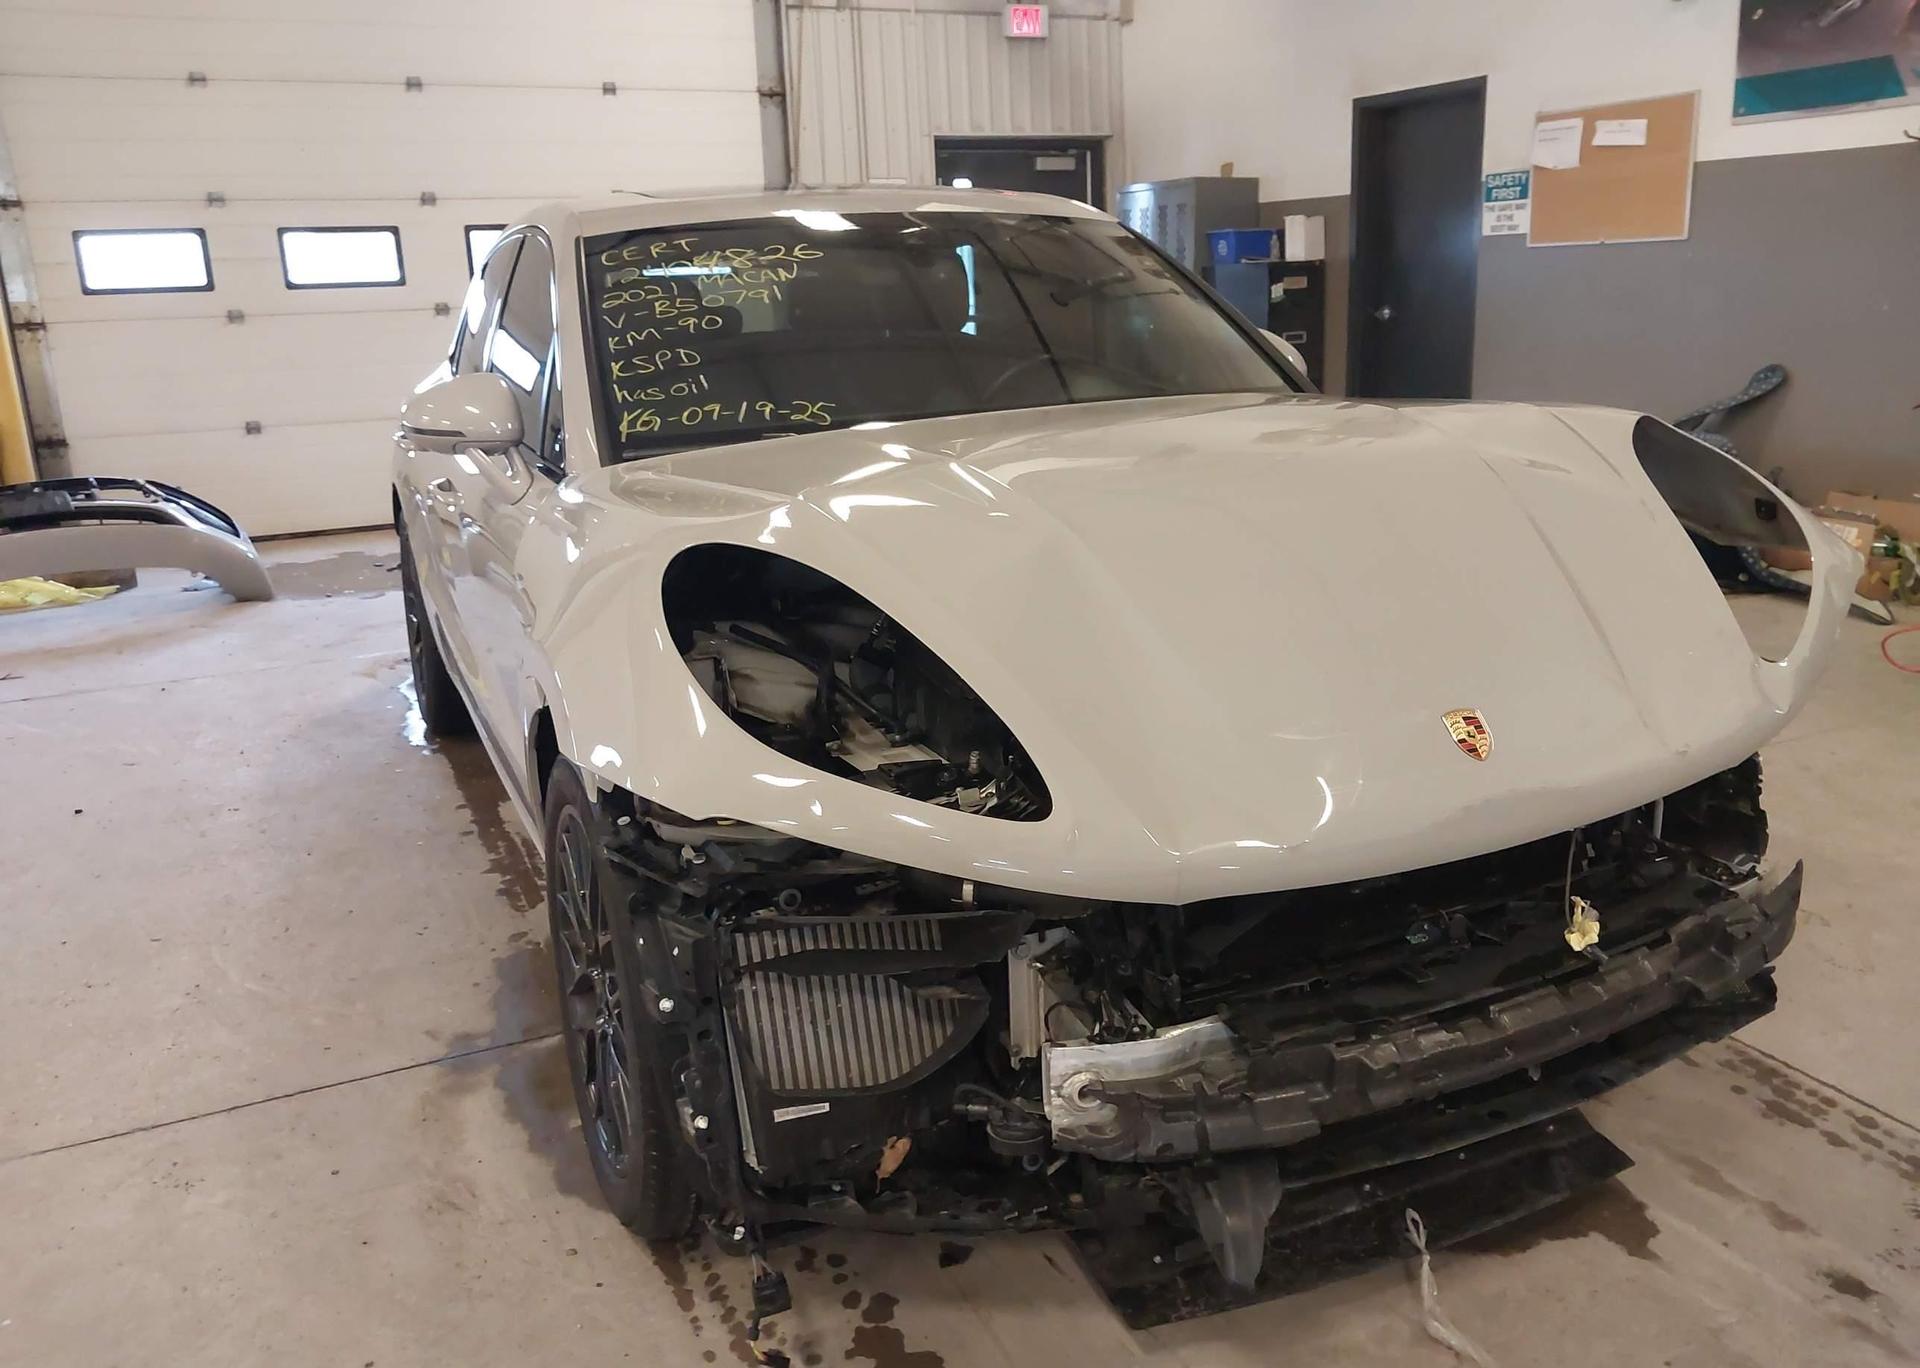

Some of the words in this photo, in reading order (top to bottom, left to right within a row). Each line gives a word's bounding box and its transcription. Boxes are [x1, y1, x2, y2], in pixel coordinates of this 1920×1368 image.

[1487, 173, 1529, 188] SAFETY
[1491, 186, 1522, 201] FIRST
[601, 238, 700, 266] CERT
[602, 281, 678, 309] 2021
[697, 262, 798, 289] MACAN
[610, 348, 701, 380] KSPD
